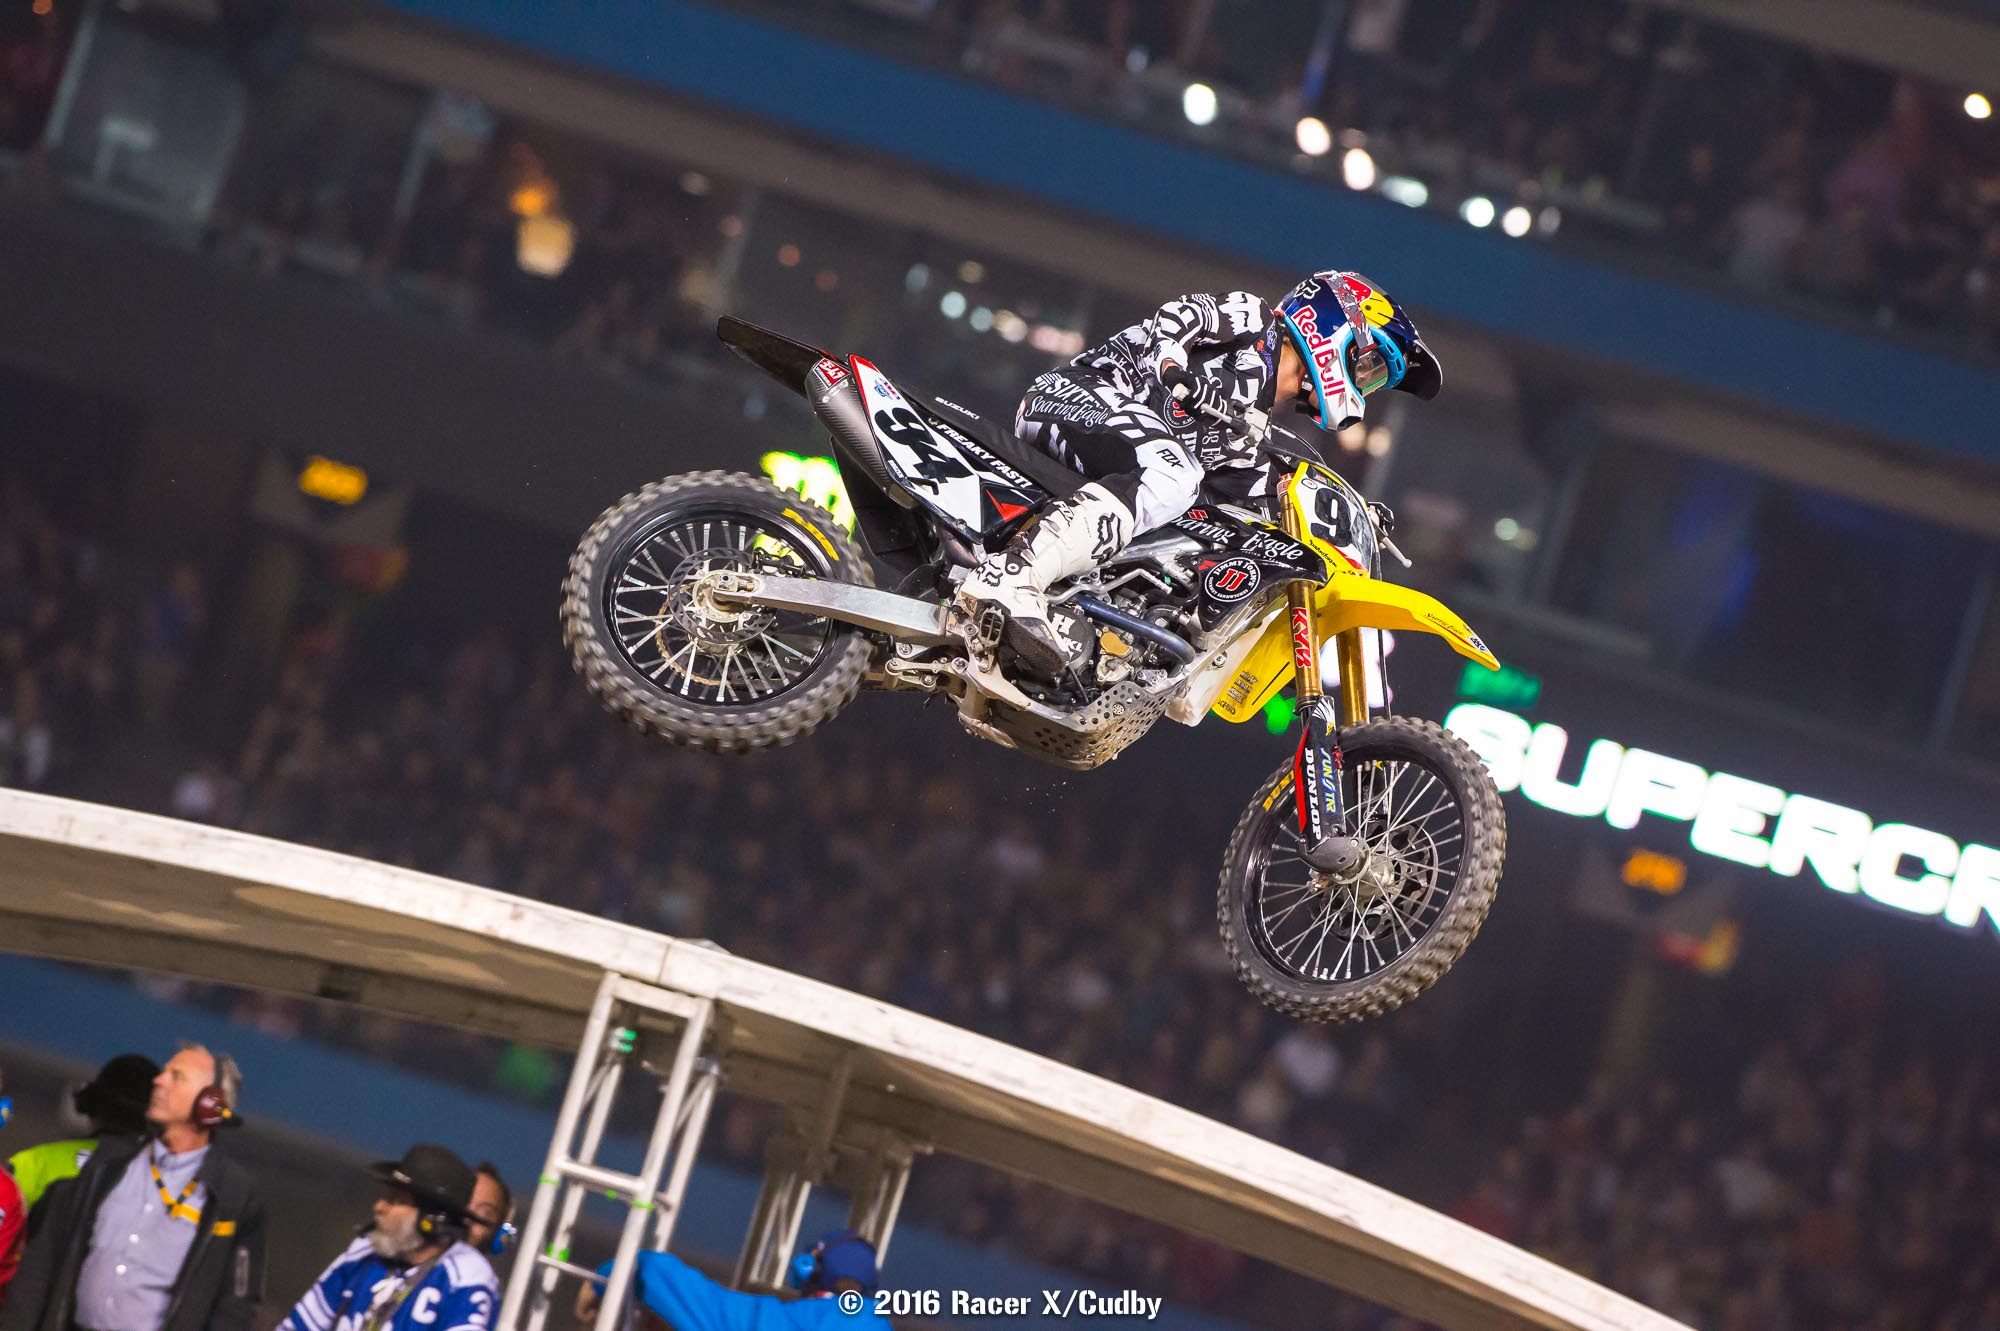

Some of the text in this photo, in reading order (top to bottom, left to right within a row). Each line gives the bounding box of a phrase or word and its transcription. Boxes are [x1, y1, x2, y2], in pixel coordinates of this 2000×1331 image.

[1292, 305, 1346, 397] Red Bull
[935, 396, 980, 419] SUZUKI
[1025, 396, 1079, 421] Soaring
[874, 407, 974, 483] 94
[937, 424, 1032, 488] FREAKY FAST!
[1156, 448, 1184, 468] FOX
[1240, 531, 1304, 561] Eagle
[1213, 560, 1243, 576] JIMMY
[1215, 568, 1249, 591] JJ
[1292, 606, 1312, 668] KYB
[1304, 748, 1322, 840] DUNLOP
[411, 1286, 442, 1325] C
